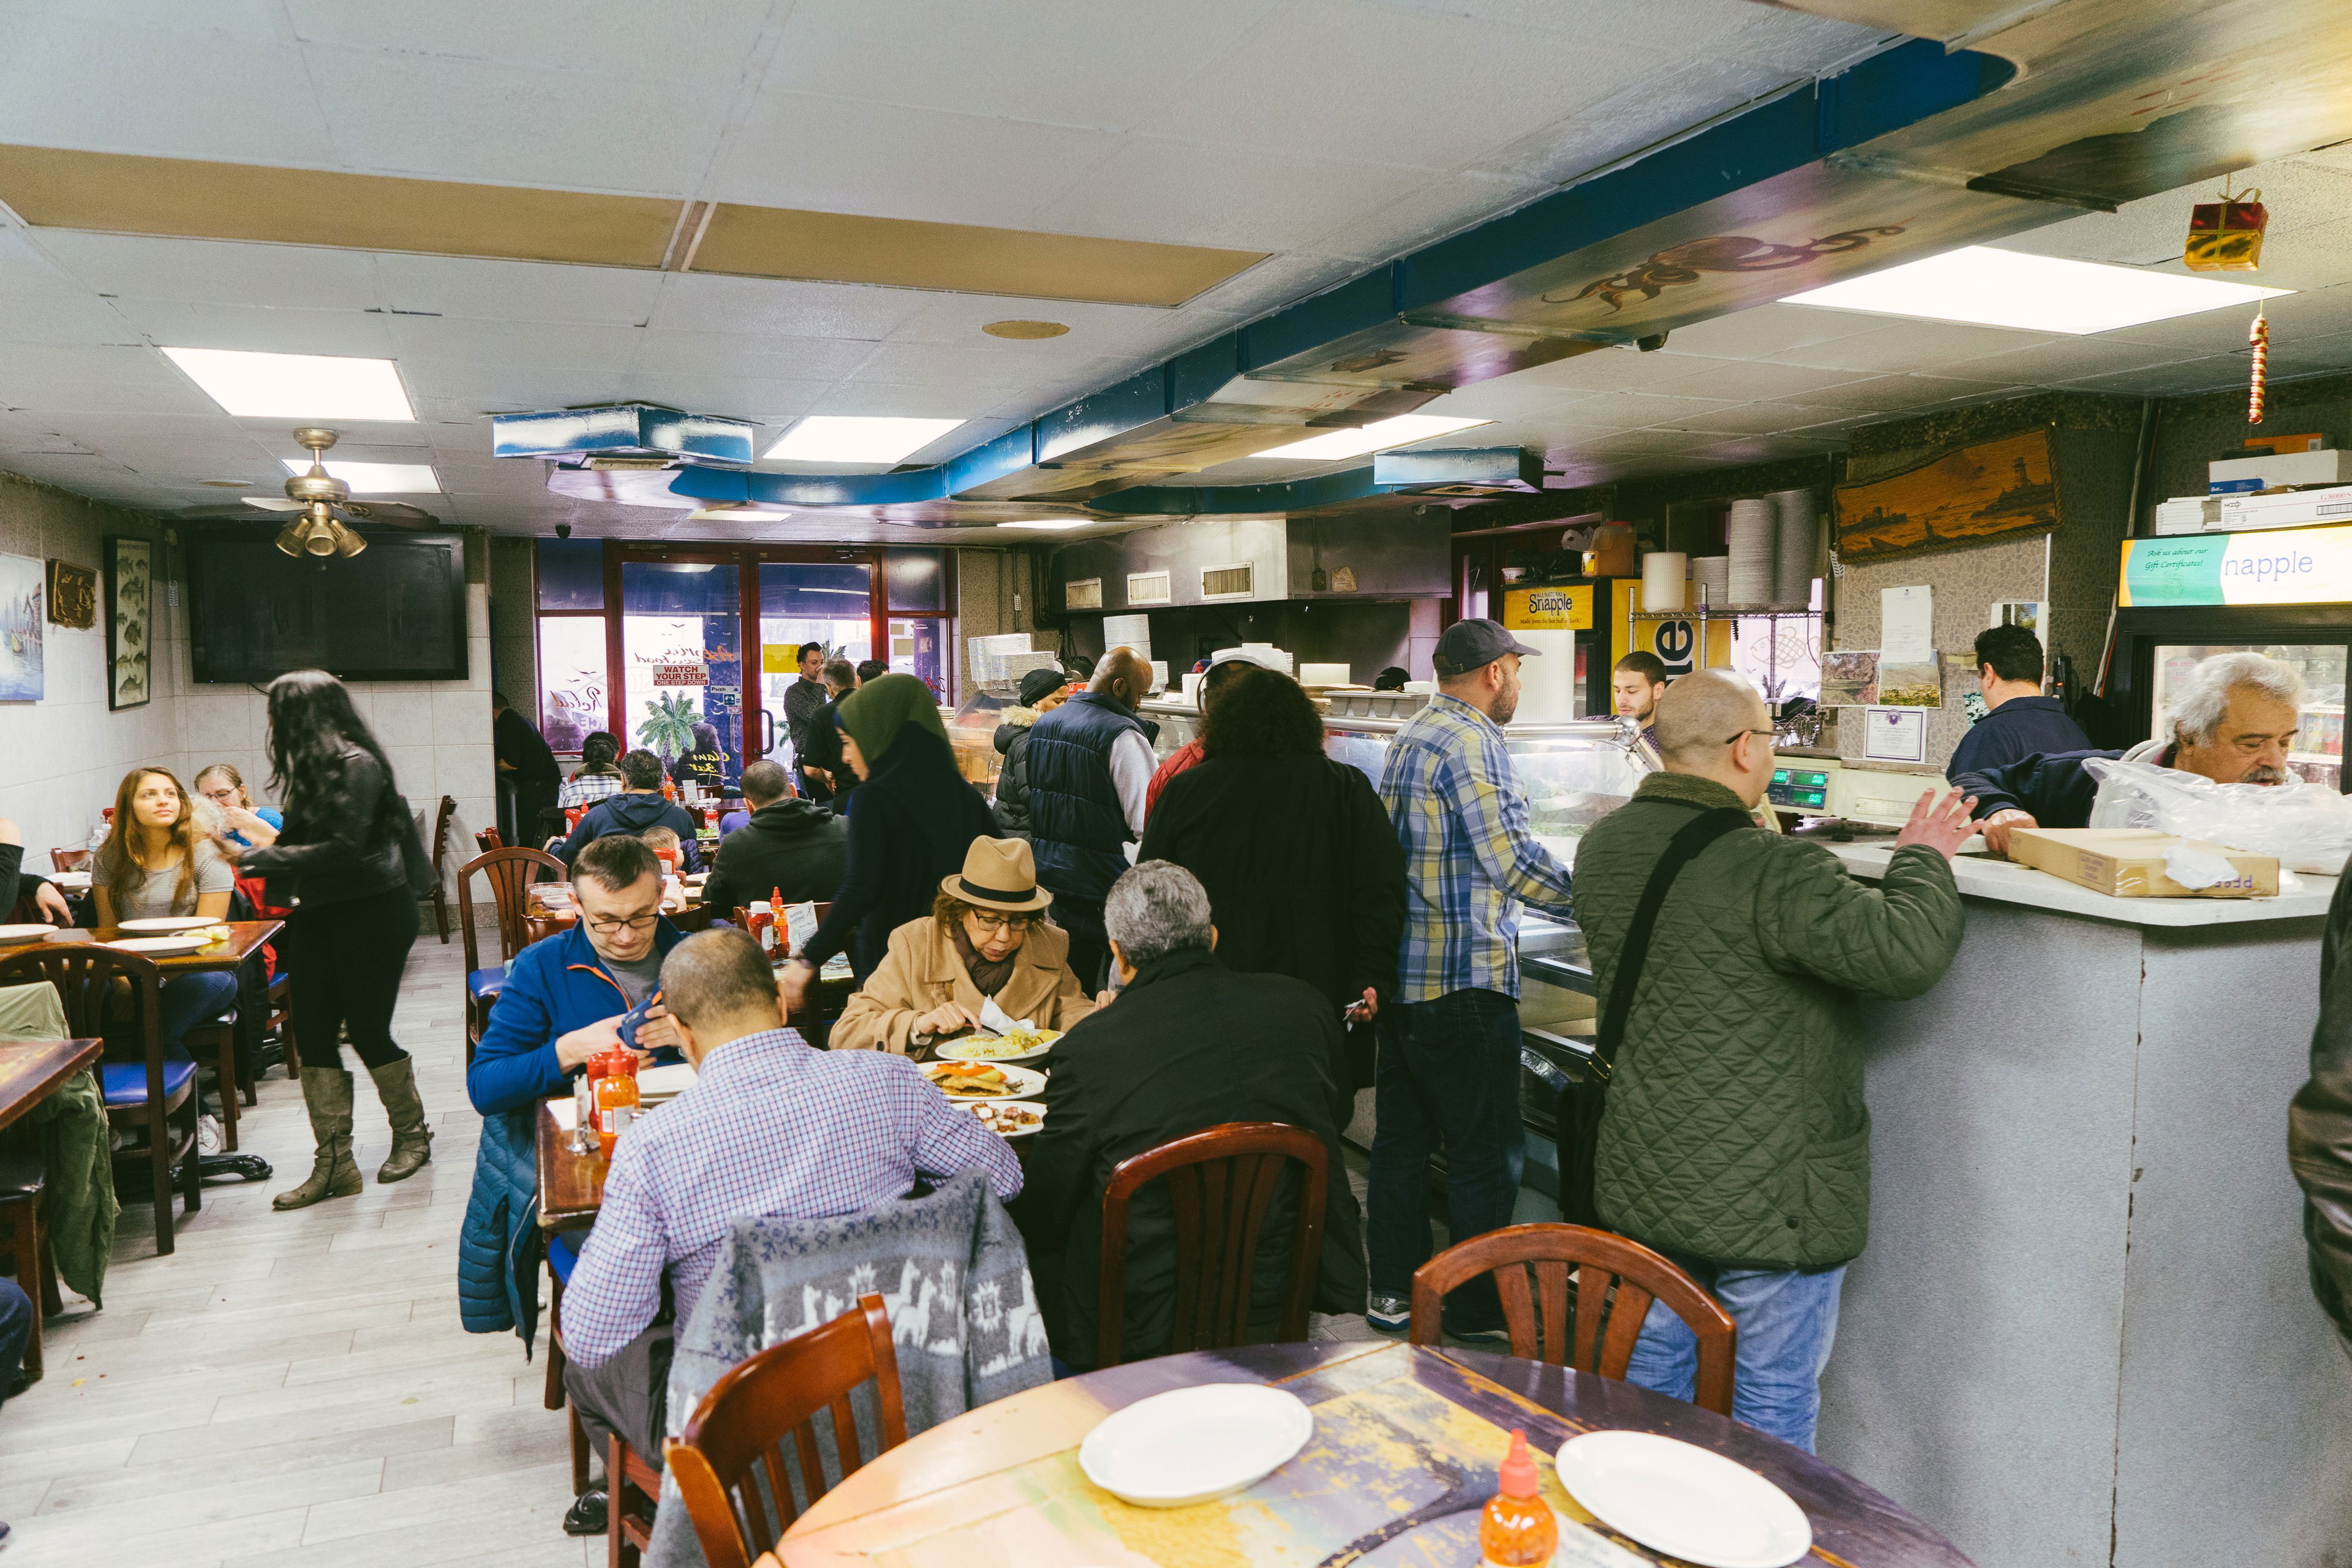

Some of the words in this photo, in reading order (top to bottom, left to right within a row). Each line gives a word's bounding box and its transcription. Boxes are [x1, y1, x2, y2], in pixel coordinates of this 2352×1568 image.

[2145, 560, 2159, 571] Gift
[2160, 559, 2204, 571] Certificates!
[2225, 551, 2313, 582] napple
[1528, 593, 1573, 616] Snapple
